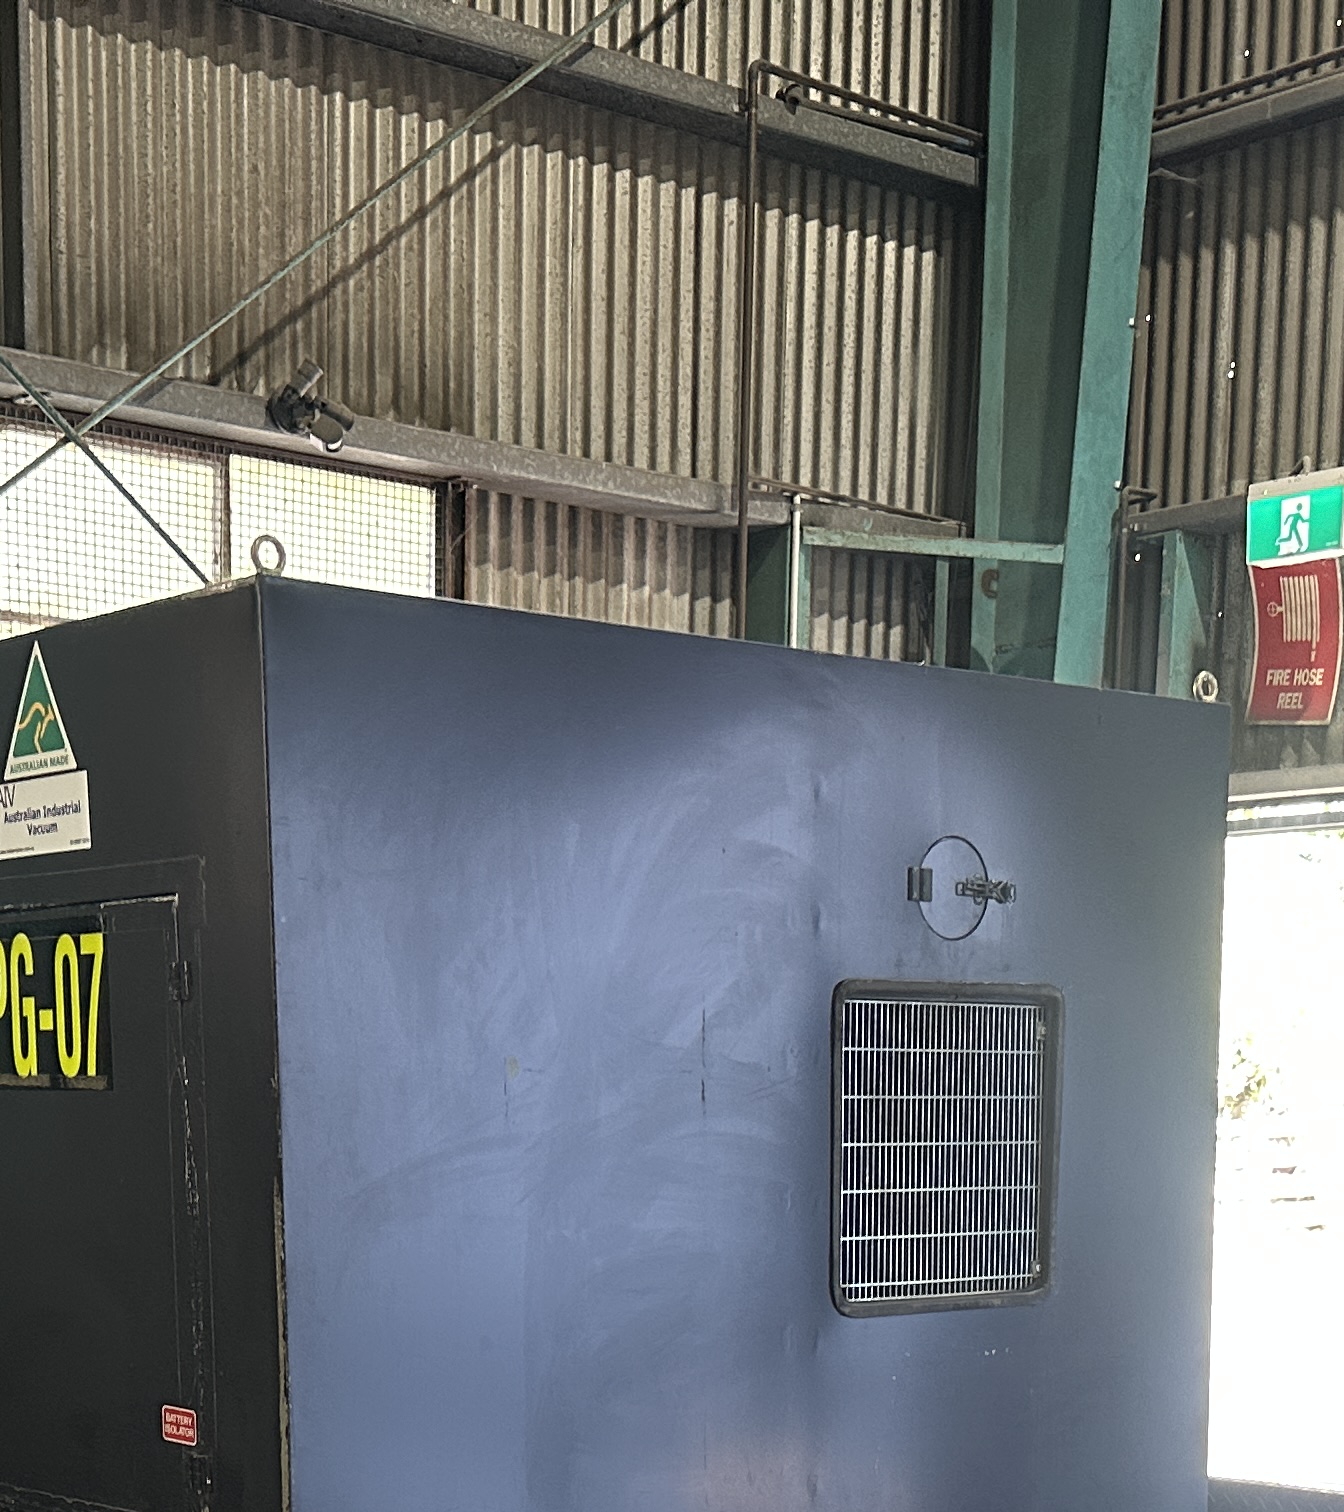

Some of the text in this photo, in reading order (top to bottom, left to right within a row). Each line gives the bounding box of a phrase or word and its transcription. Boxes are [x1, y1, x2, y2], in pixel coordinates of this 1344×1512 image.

[1266, 667, 1324, 687] FIRE HOSE
[1276, 692, 1304, 710] REEL
[9, 754, 70, 775] AUSTRALIAN MADE
[3, 799, 82, 824] Australian Industrial
[26, 822, 59, 836] Vacuum
[165, 1412, 193, 1426] BATTERY
[164, 1424, 195, 1438] ISOLATOR
